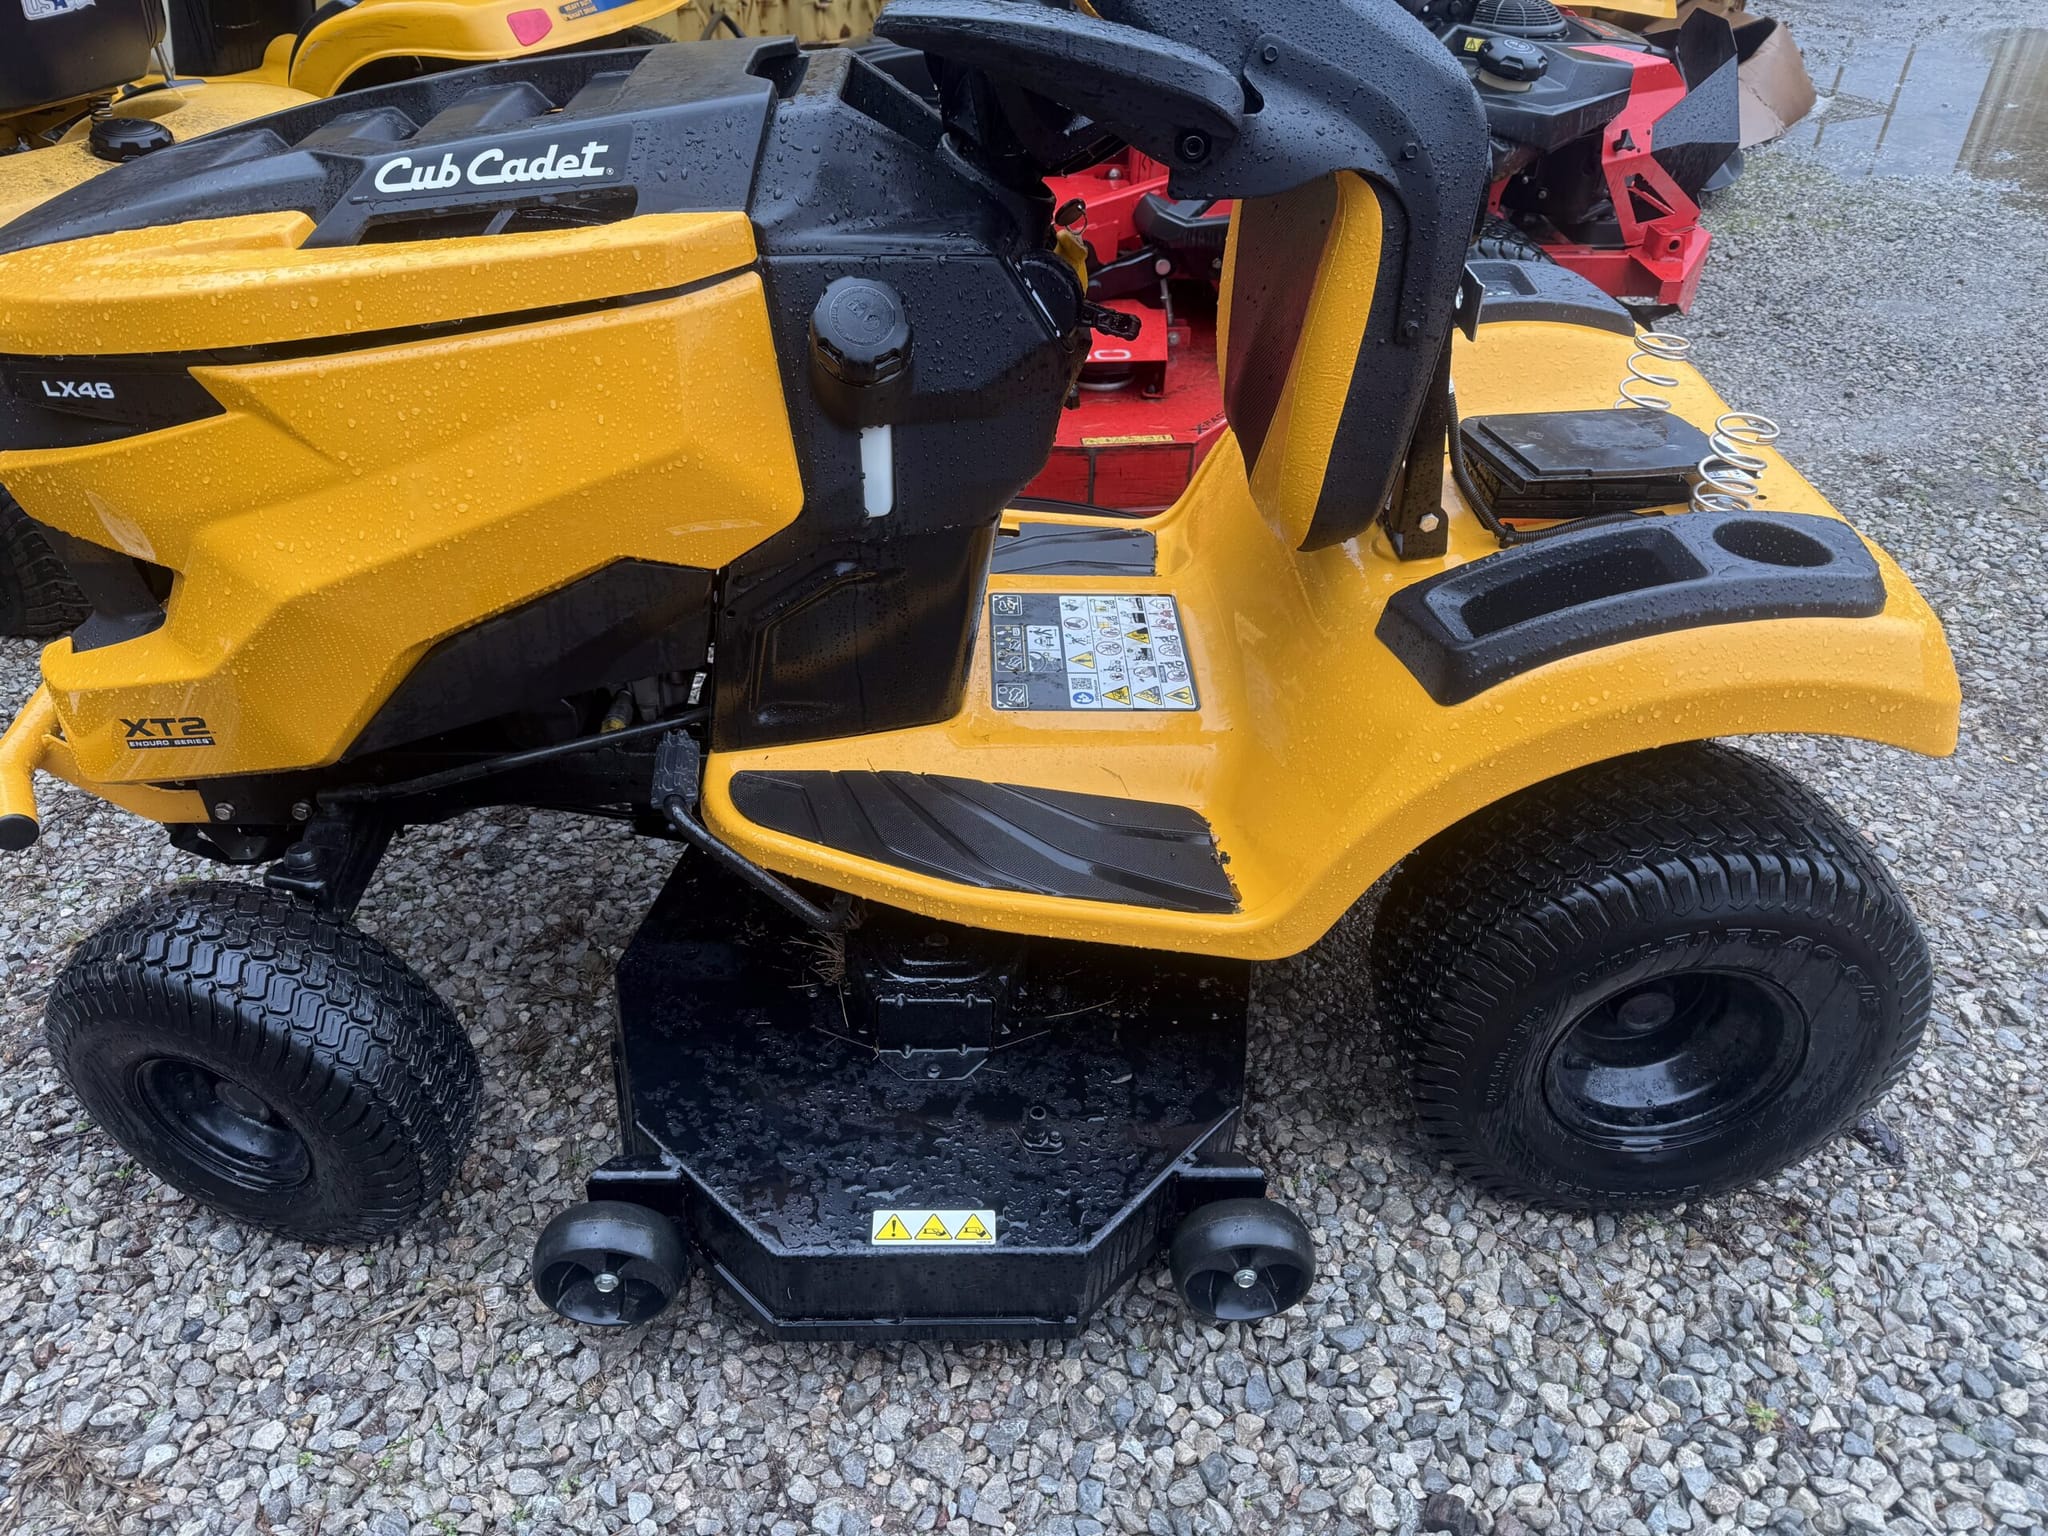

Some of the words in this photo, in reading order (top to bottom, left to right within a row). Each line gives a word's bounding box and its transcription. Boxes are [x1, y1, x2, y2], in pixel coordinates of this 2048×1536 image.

[374, 152, 462, 193] Cub
[466, 141, 609, 186] Cadet
[41, 380, 115, 399] LX46
[118, 717, 210, 737] XT2
[128, 739, 170, 748] ENDURO
[173, 738, 210, 746] SERIES
